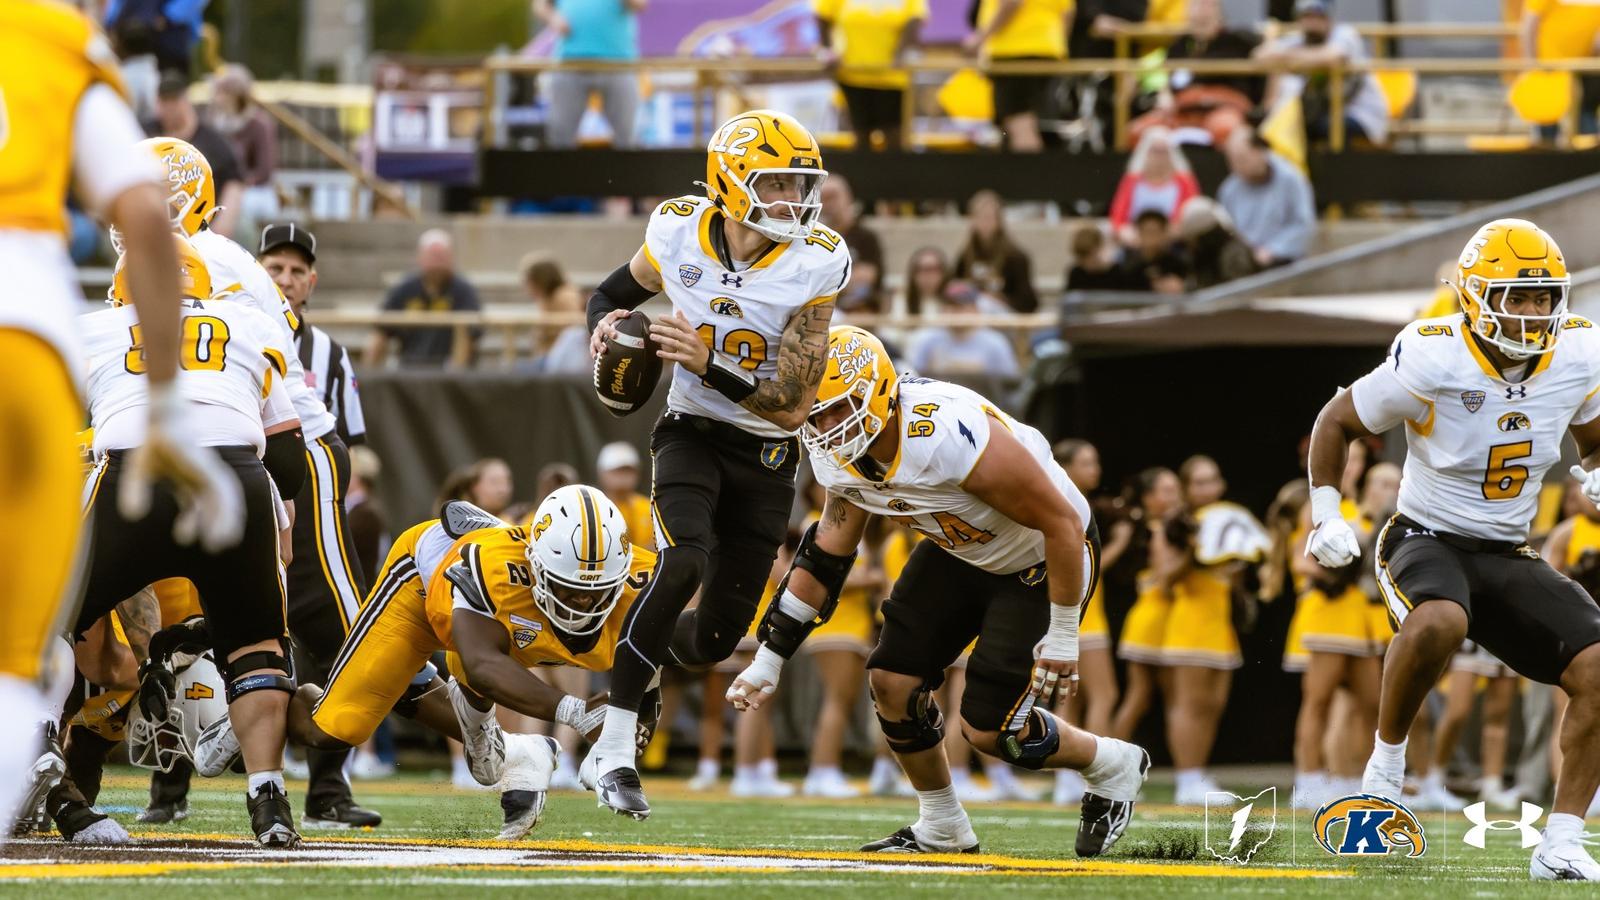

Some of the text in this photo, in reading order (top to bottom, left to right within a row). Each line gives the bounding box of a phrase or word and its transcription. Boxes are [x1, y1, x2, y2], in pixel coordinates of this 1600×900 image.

[714, 124, 759, 157] 12
[169, 166, 203, 191] State
[805, 228, 841, 253] 12
[1462, 238, 1489, 269] 5
[1418, 325, 1454, 337] 5
[611, 357, 632, 395] Flashes
[840, 348, 874, 384] State
[908, 402, 940, 438] 54
[533, 513, 553, 542] 2
[506, 561, 532, 588] 2
[579, 574, 602, 582] GRIT
[185, 682, 214, 700] 4
